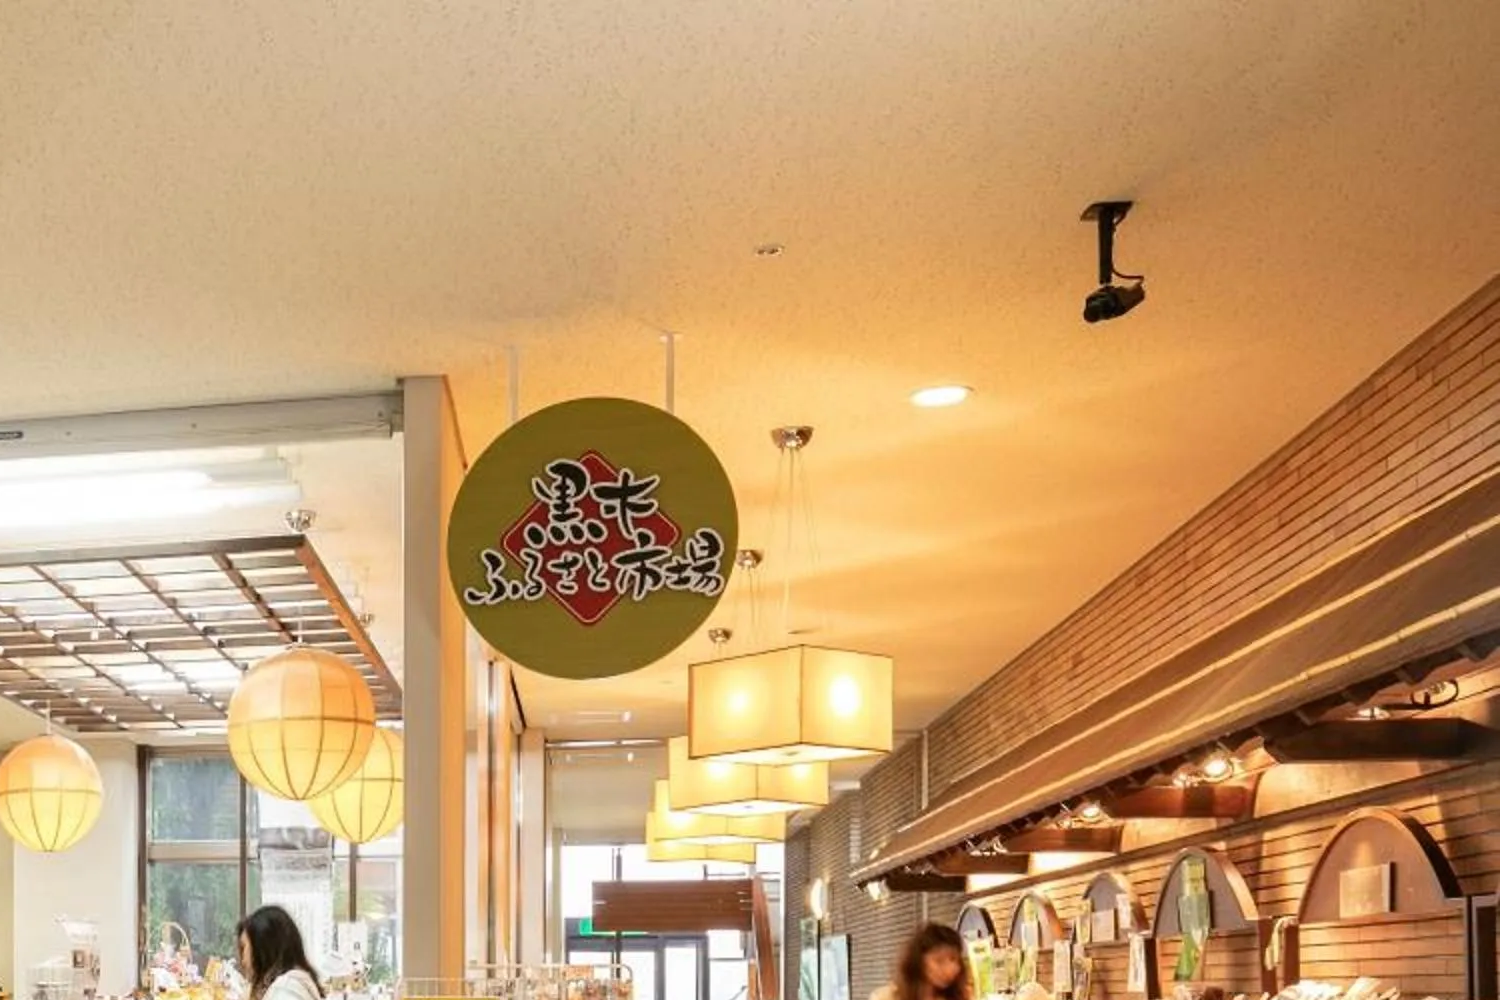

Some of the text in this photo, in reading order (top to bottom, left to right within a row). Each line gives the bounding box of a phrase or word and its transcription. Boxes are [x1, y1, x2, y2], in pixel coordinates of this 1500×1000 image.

[524, 458, 660, 548] 黒木
[464, 529, 723, 604] ふるさと市場
